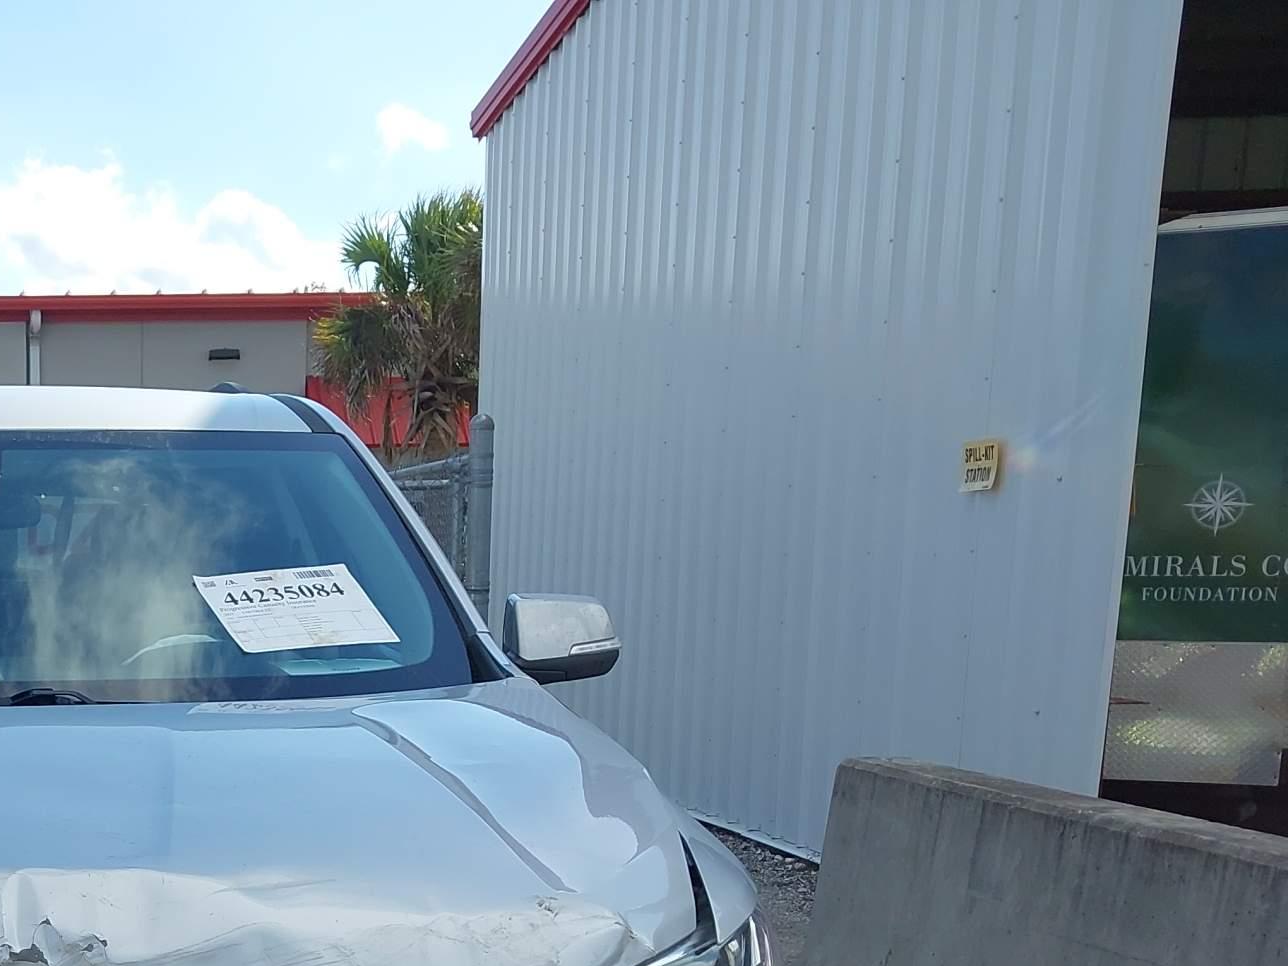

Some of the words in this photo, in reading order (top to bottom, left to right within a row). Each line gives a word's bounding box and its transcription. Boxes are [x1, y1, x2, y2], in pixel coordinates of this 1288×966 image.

[965, 445, 994, 463] SPILL-KIT
[965, 466, 992, 484] STATION
[1262, 554, 1288, 577] C
[224, 582, 345, 606] 44235084
[1142, 586, 1279, 602] FOUNDATION
